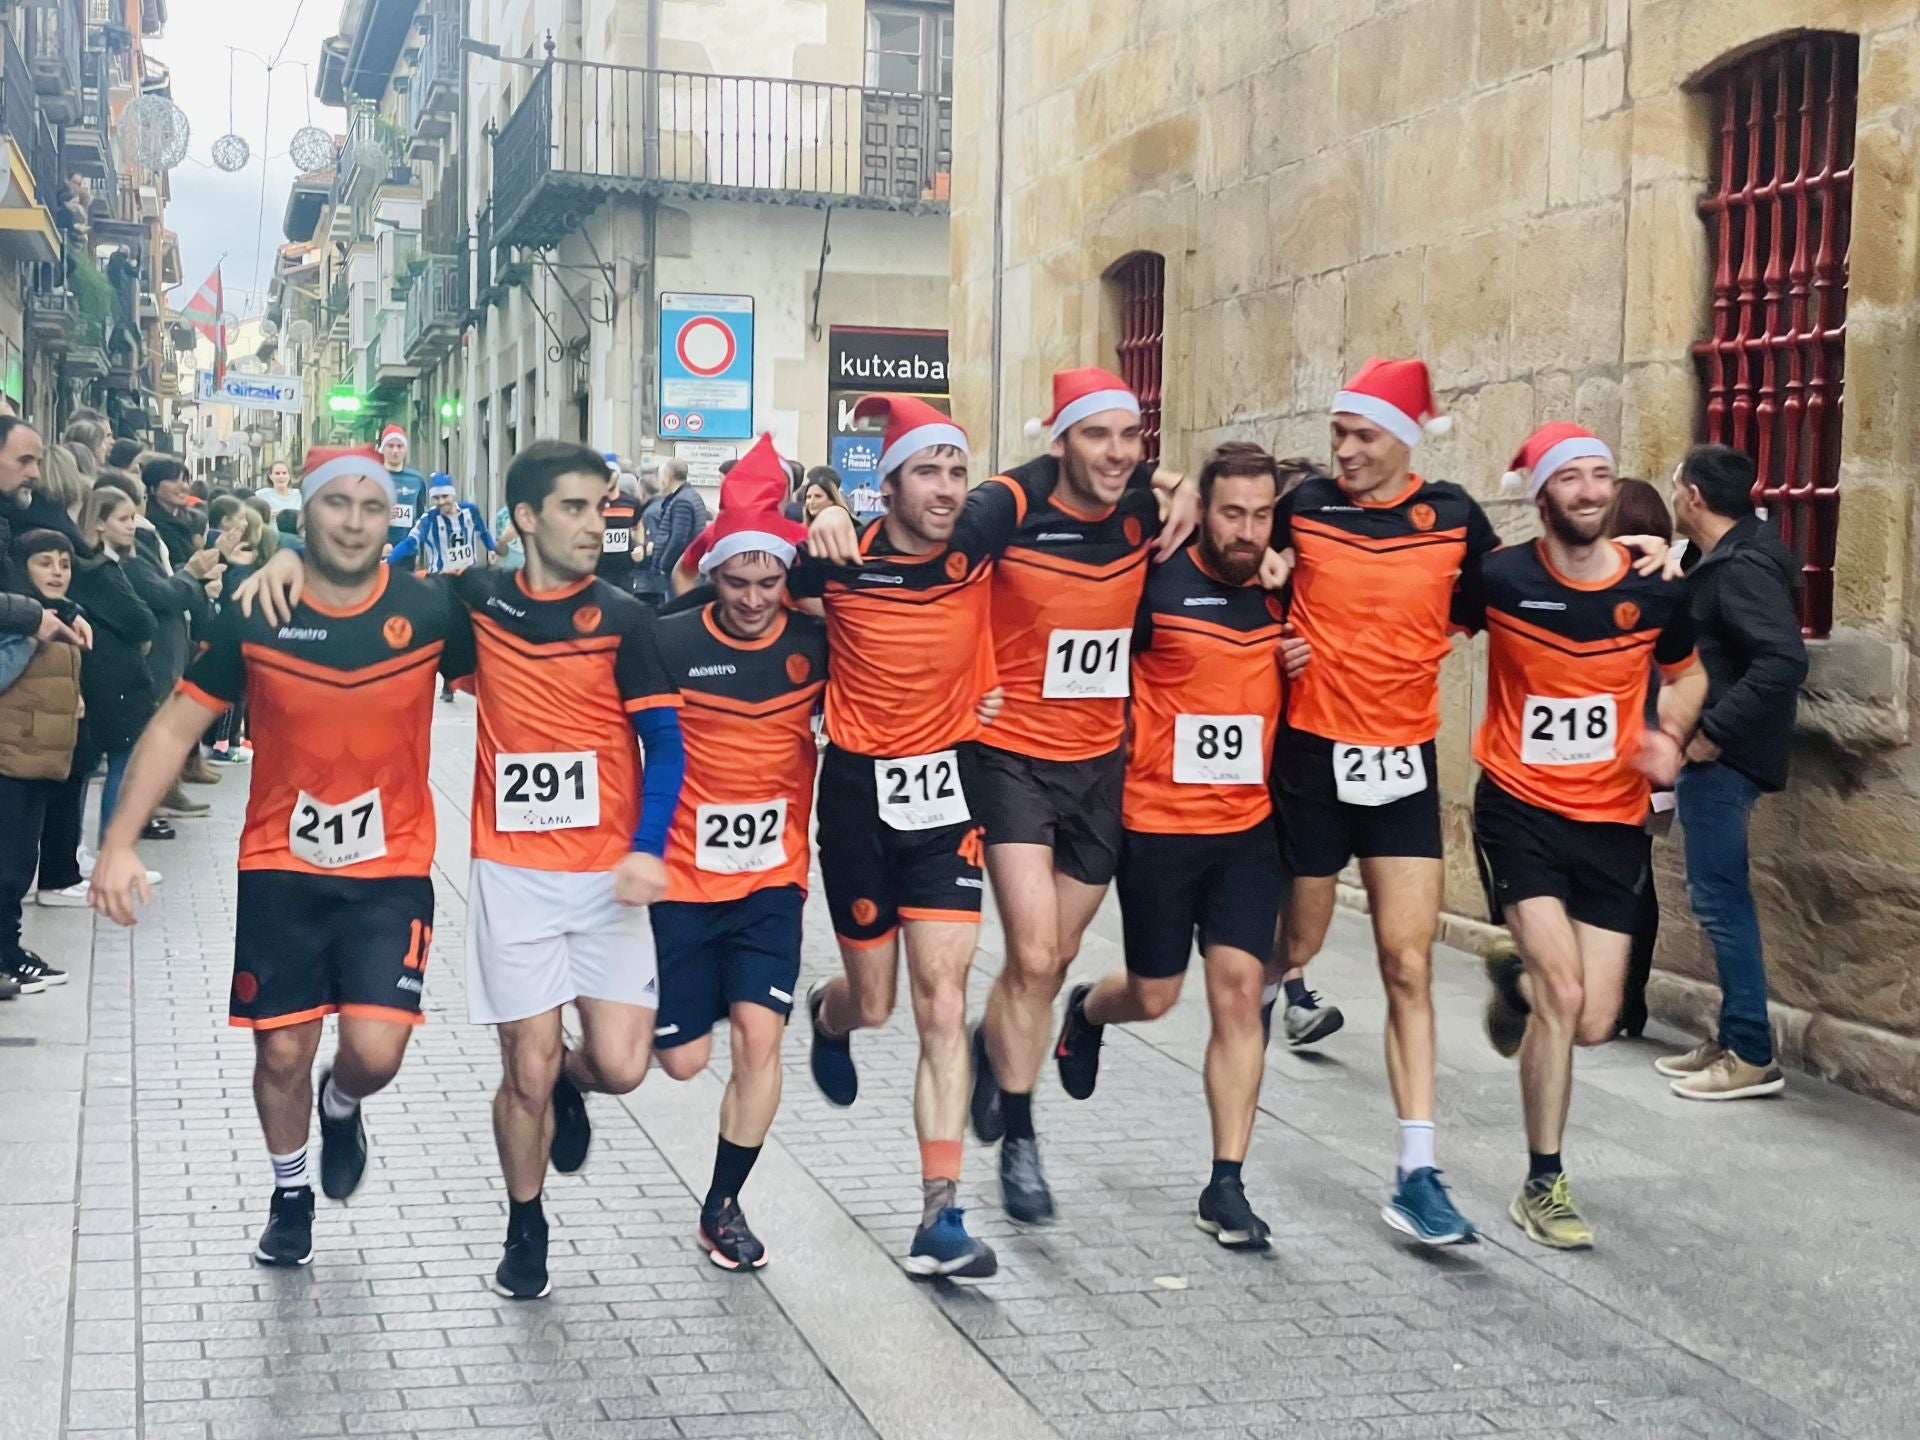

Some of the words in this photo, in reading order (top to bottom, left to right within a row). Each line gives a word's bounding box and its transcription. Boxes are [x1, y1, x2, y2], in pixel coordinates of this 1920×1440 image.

[840, 351, 949, 380] kutxaba
[449, 547, 471, 562] 310
[605, 532, 627, 544] 309
[1056, 637, 1120, 674] 101
[1531, 705, 1607, 741] 218
[1196, 724, 1243, 760] 89
[503, 760, 584, 802] 291
[1343, 746, 1414, 781] 213
[886, 761, 955, 804] 212
[296, 801, 374, 845] 217
[540, 816, 571, 825] LANA
[705, 809, 778, 849] 292
